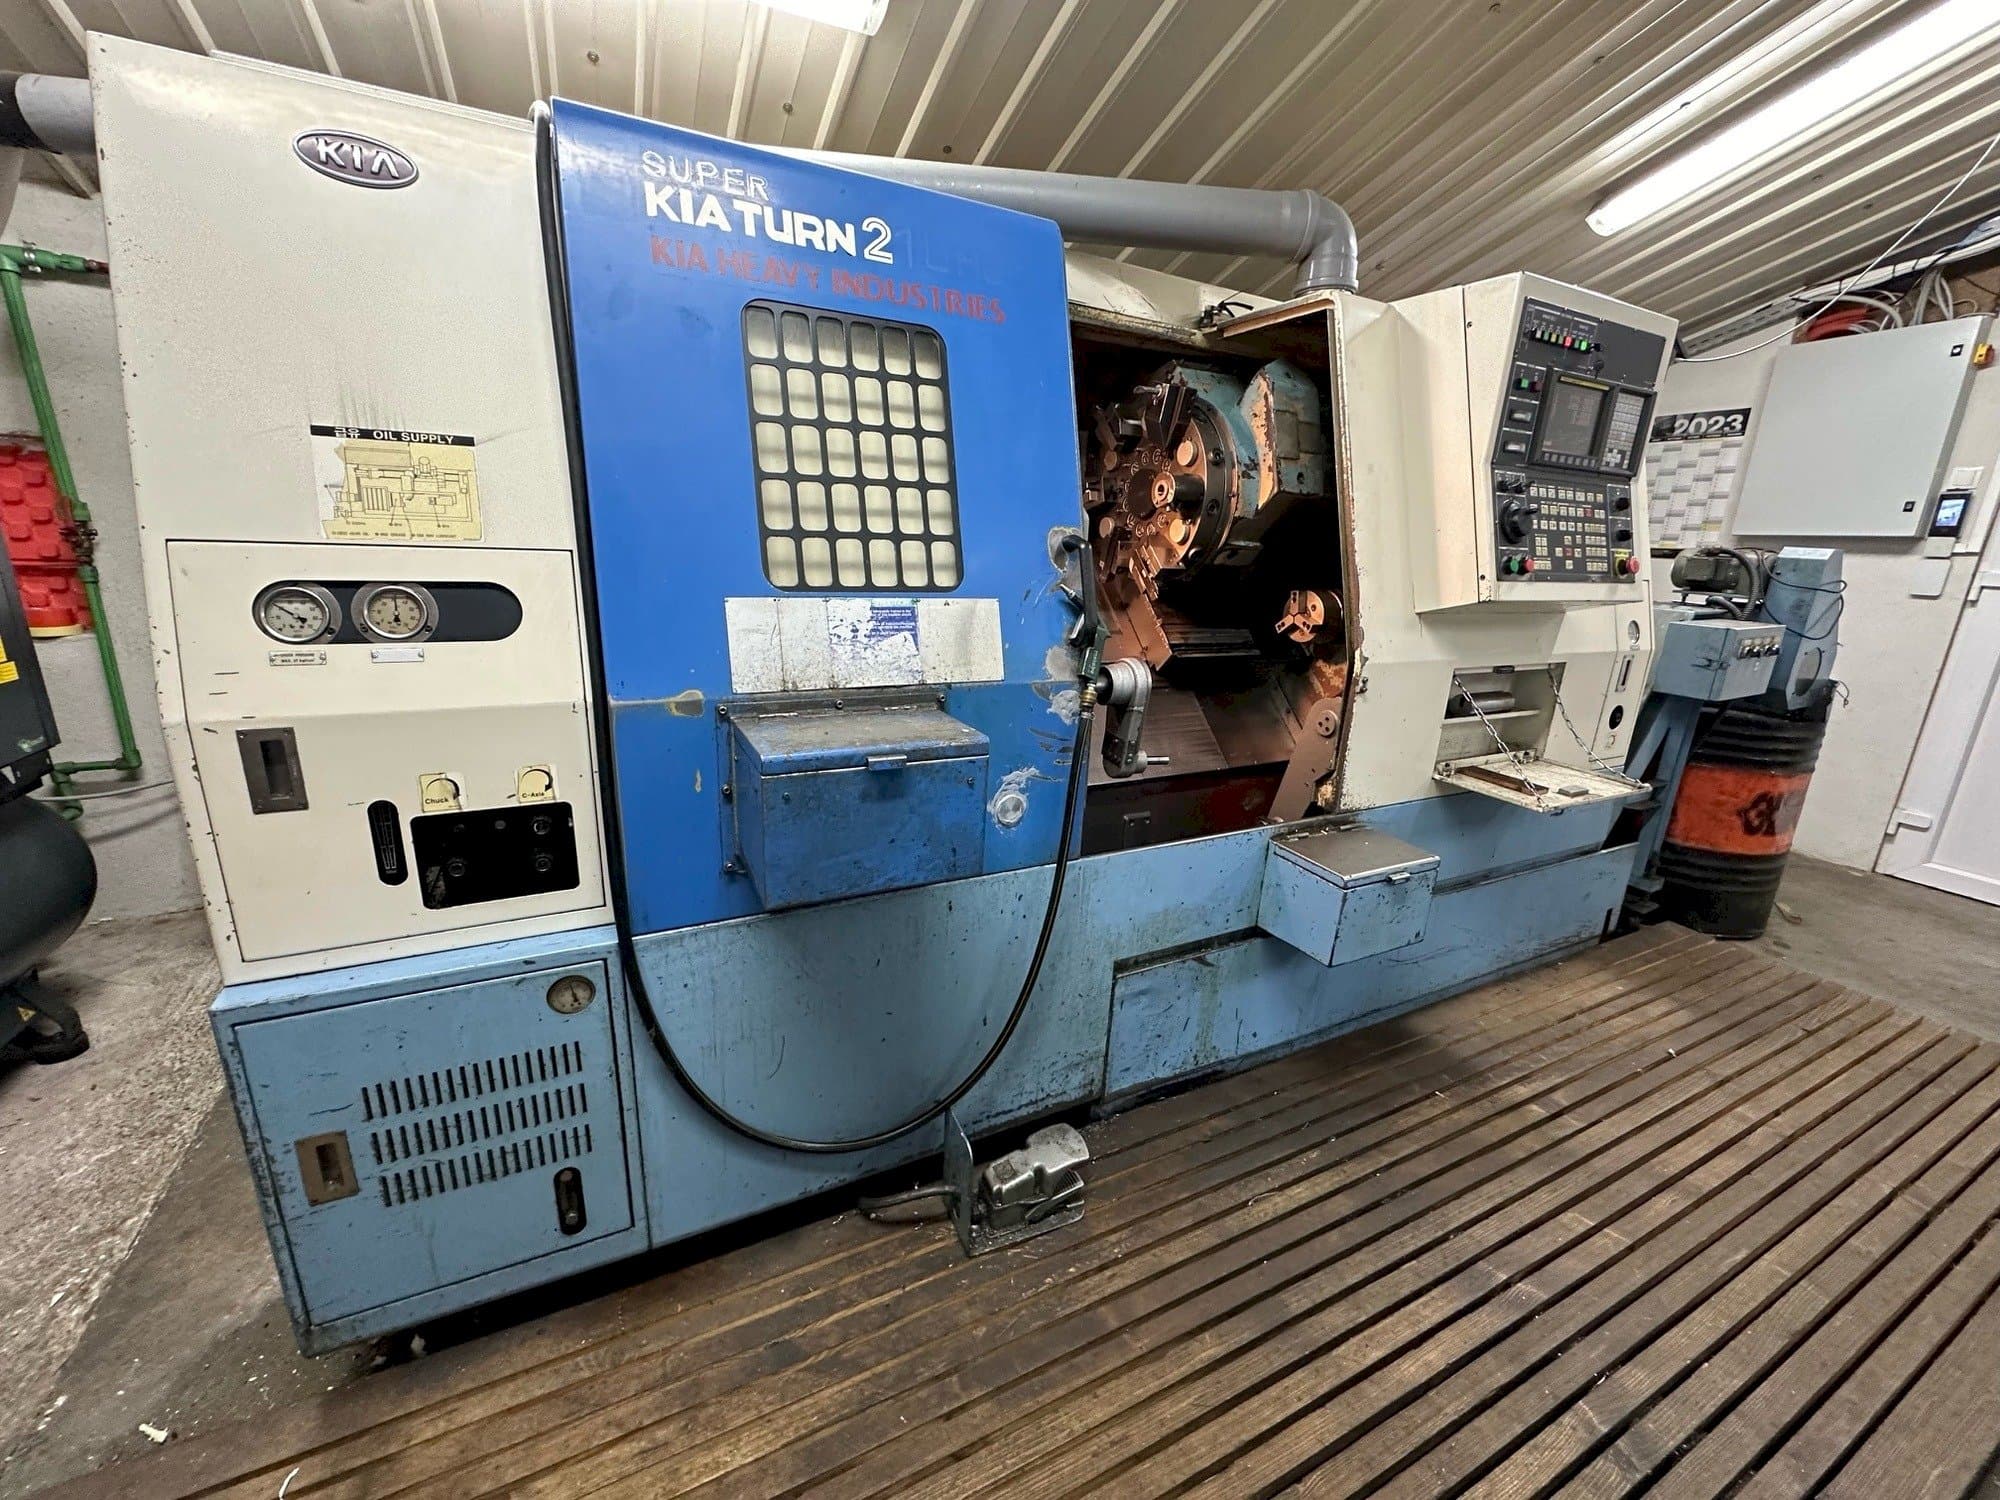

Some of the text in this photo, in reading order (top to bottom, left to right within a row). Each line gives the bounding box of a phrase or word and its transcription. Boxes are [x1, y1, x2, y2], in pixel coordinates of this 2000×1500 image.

[315, 137, 399, 179] KIA
[641, 150, 770, 201] SUPER
[861, 216, 894, 265] 2
[650, 233, 1007, 325] KIA HEAVY INDUSTRIES
[372, 430, 454, 445] OIL SUPPLY
[1673, 414, 1744, 436] 2023
[424, 797, 449, 805] Chuck
